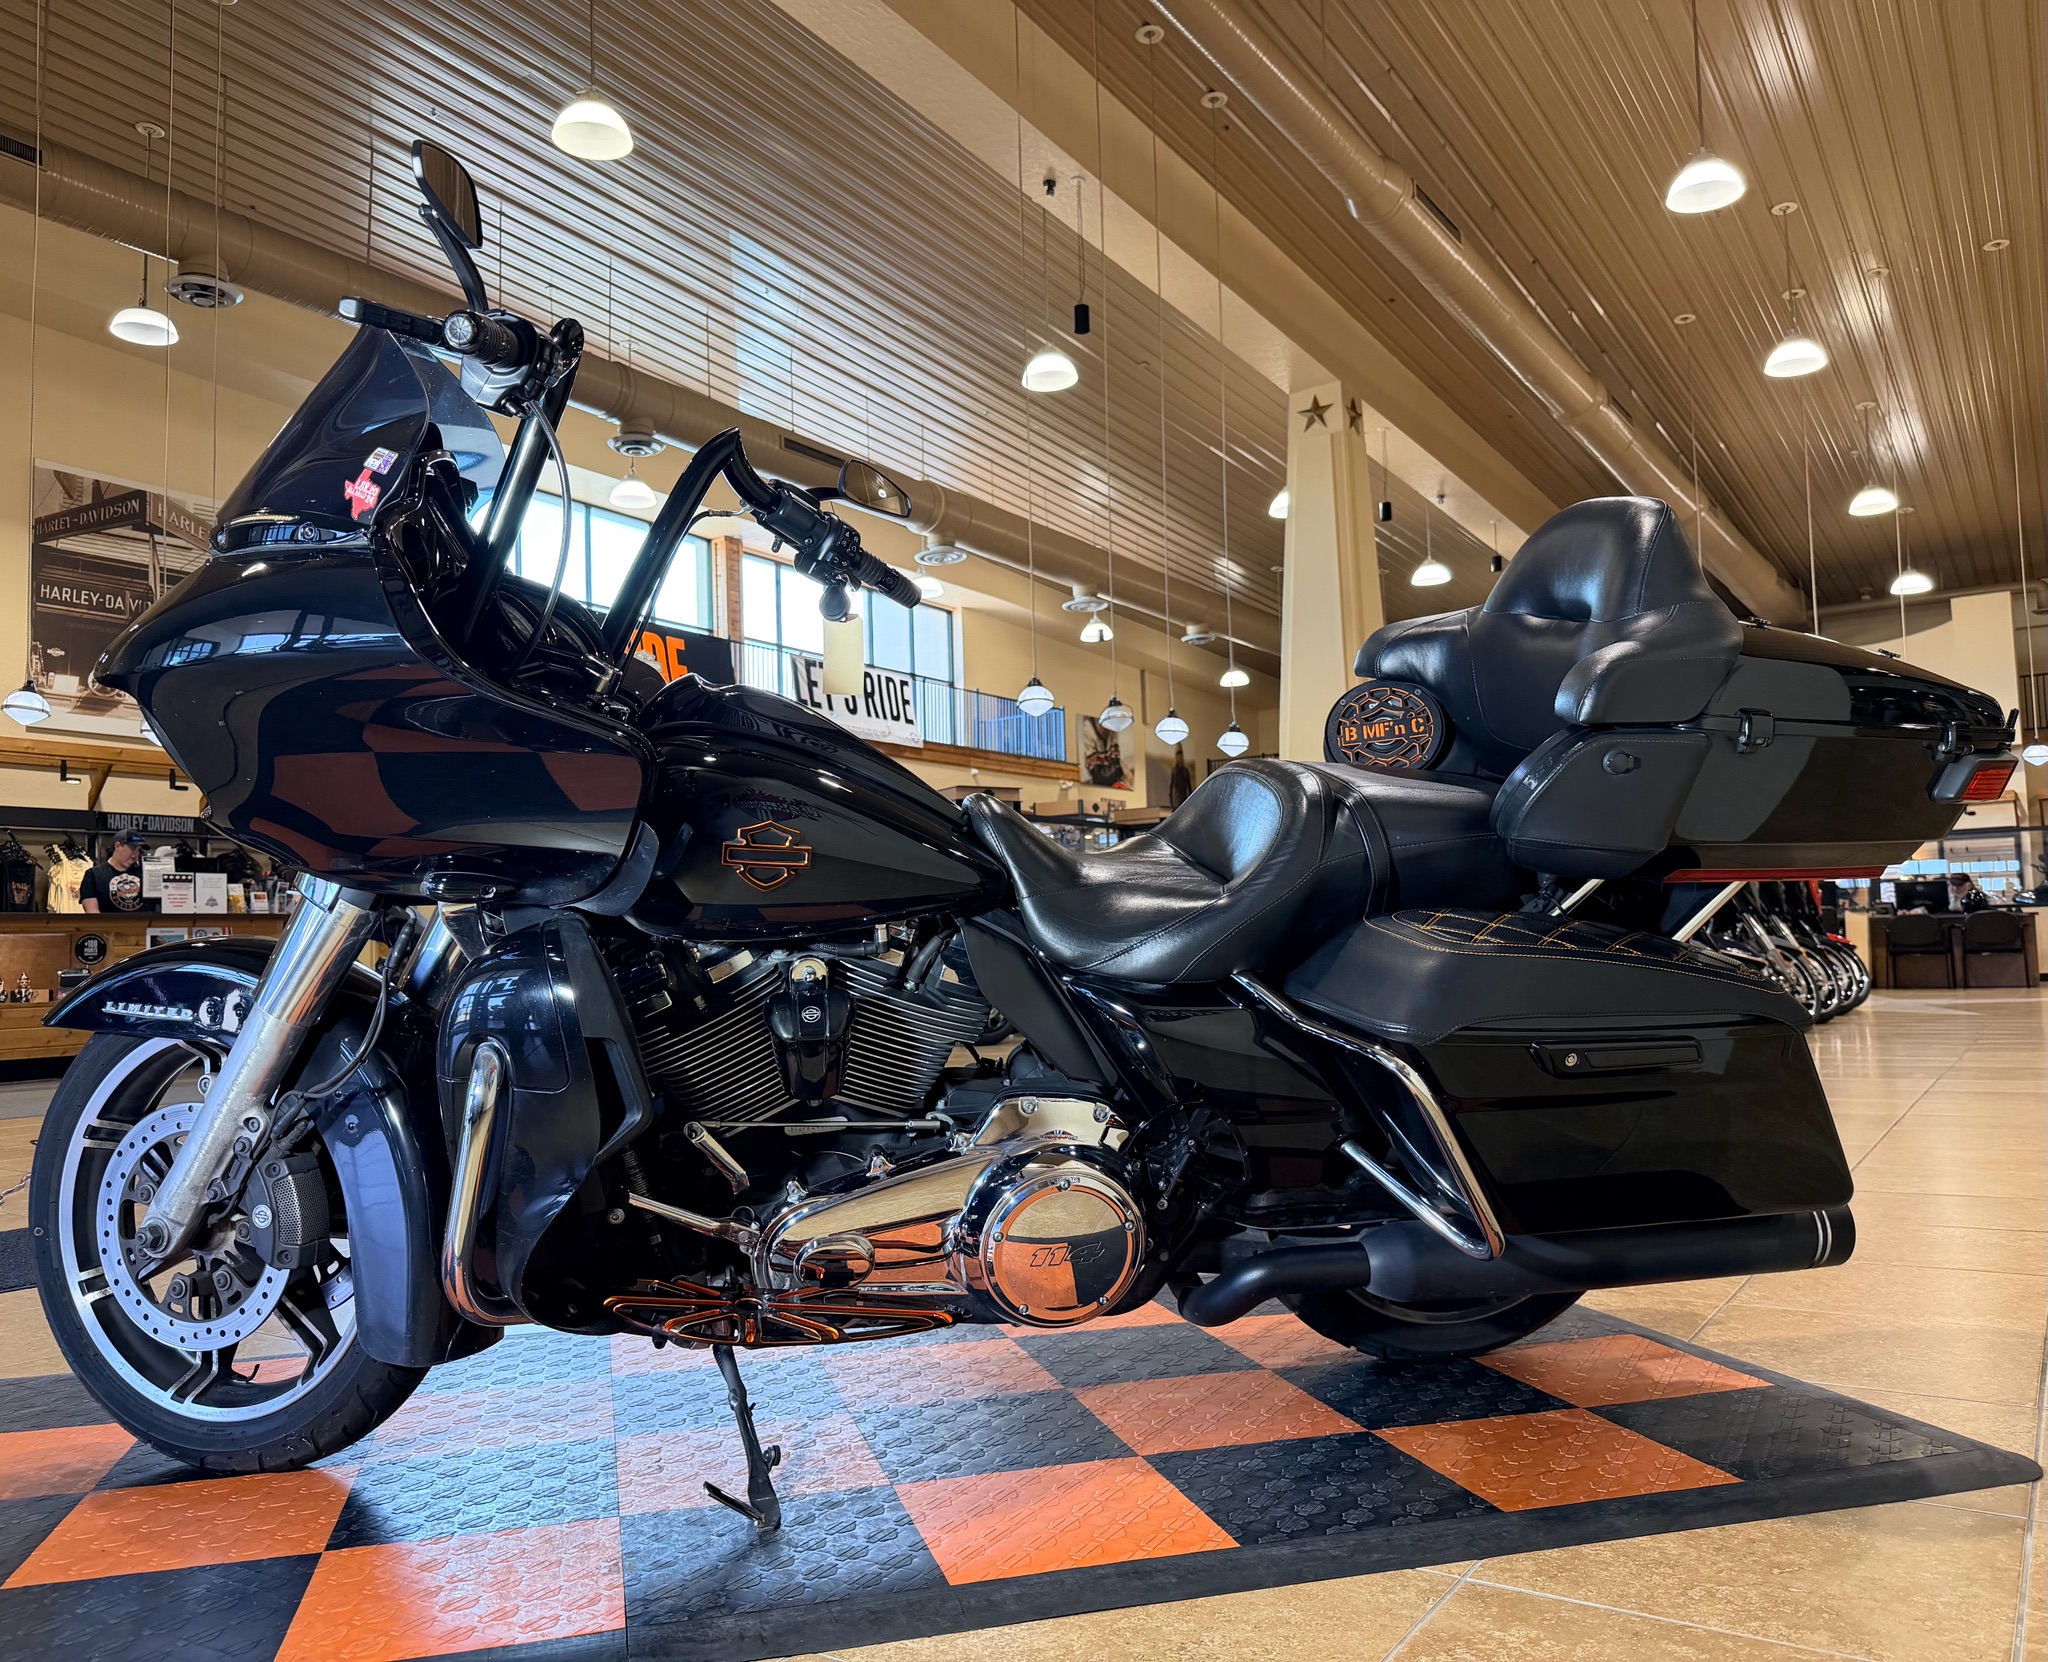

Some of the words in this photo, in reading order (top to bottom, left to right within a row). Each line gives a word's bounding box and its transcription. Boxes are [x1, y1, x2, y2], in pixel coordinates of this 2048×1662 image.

[36, 498, 141, 535] HARLEY-DAVIDSON
[158, 502, 211, 541] HARLE
[862, 671, 914, 725] RIDE
[1345, 727, 1358, 742] B
[1411, 718, 1425, 733] C
[107, 813, 195, 833] HARLEY-DAVIDSON
[105, 1001, 193, 1019] LIMITED
[1030, 1242, 1105, 1267] 114
